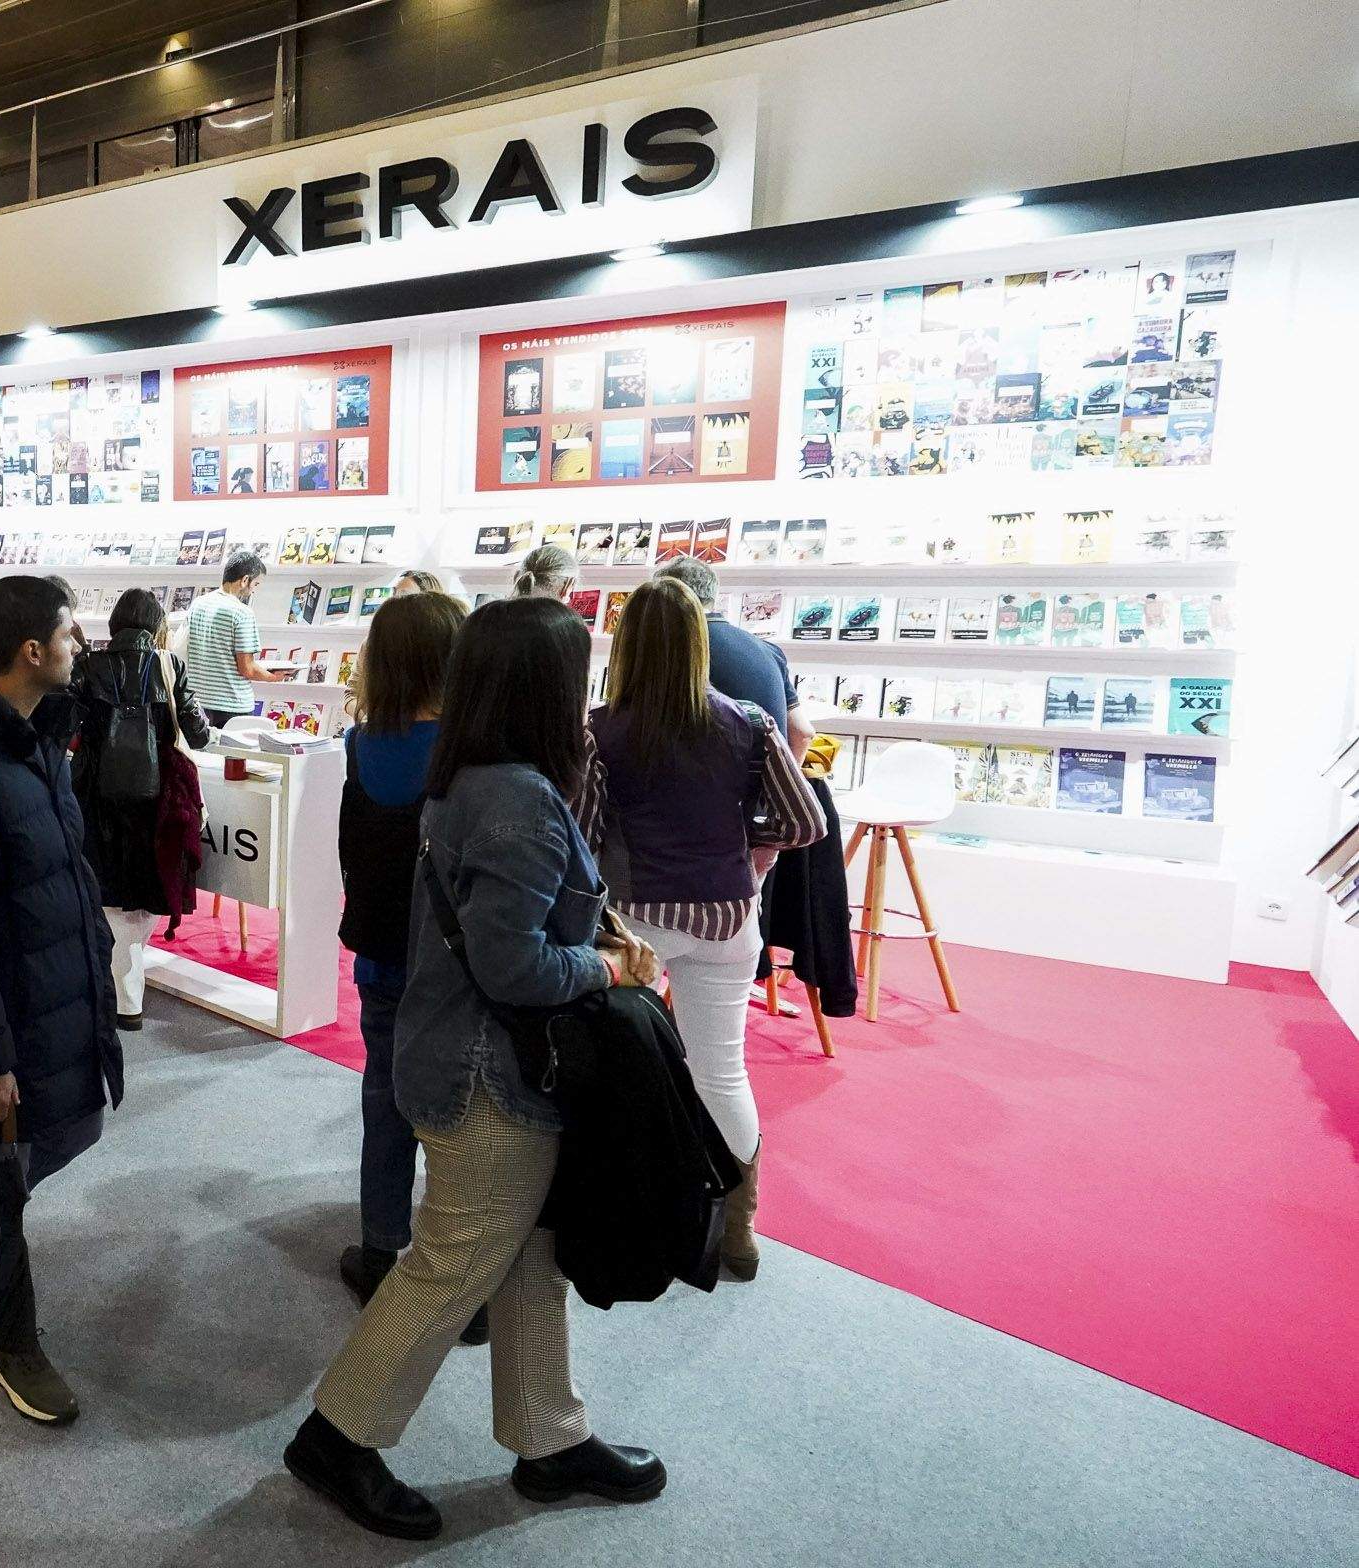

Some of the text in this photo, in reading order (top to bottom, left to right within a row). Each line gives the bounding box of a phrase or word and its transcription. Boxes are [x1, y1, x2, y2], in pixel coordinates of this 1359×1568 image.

[222, 107, 719, 266] XERAIS
[693, 321, 734, 331] XERAIS
[503, 342, 517, 351] OS
[521, 338, 550, 349] MÁIS
[811, 357, 836, 368] XXI
[1179, 697, 1222, 710] XXI
[201, 821, 259, 862] AIS
